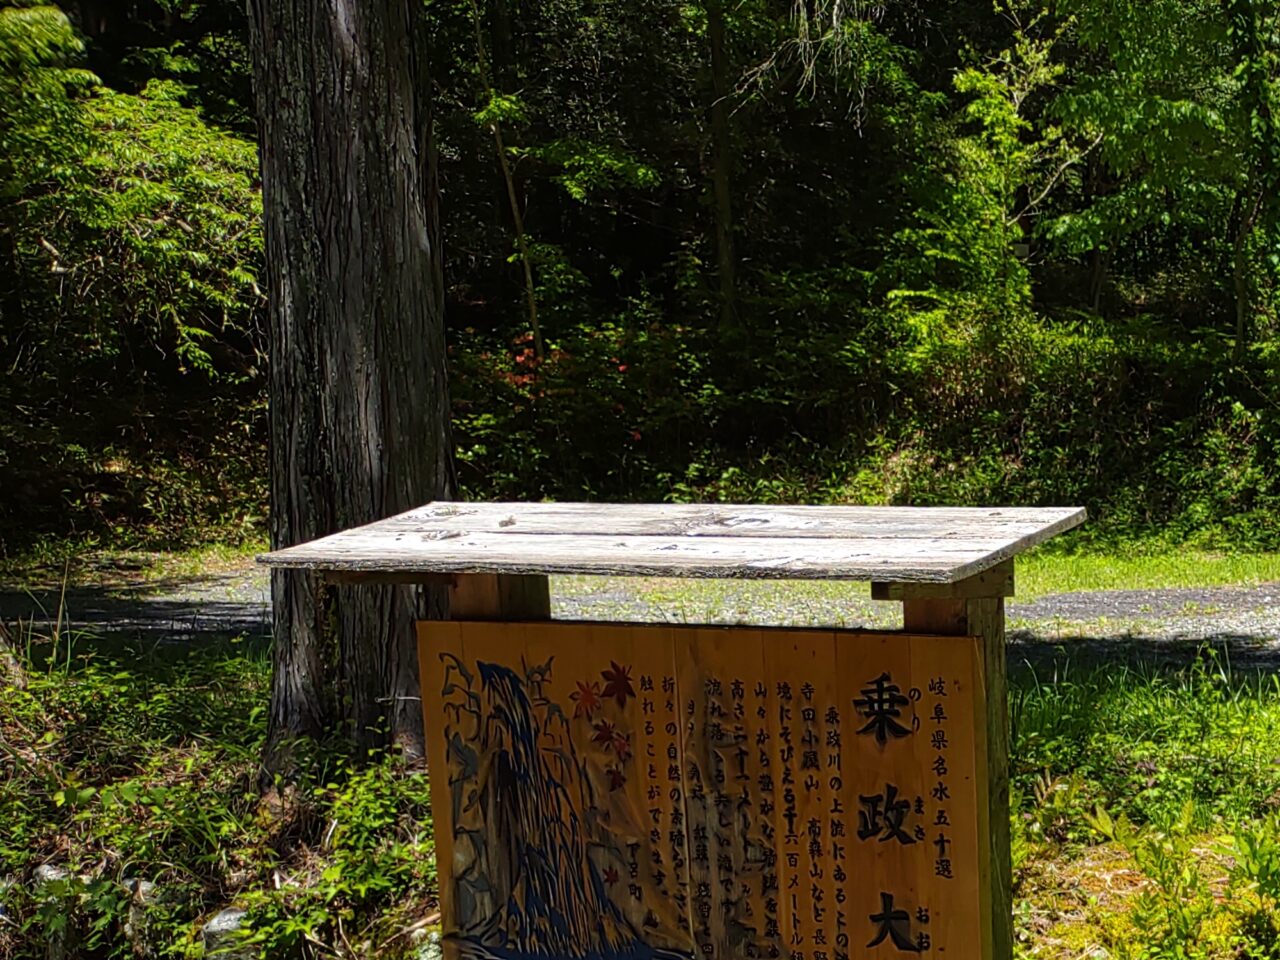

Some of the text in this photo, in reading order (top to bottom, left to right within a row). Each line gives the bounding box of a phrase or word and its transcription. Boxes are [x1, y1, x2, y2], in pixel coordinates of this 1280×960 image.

[626, 843, 642, 901] 下呂町
[908, 687, 921, 731] のり
[915, 907, 931, 951] おお
[928, 677, 954, 879] 岐阜県名水五十選
